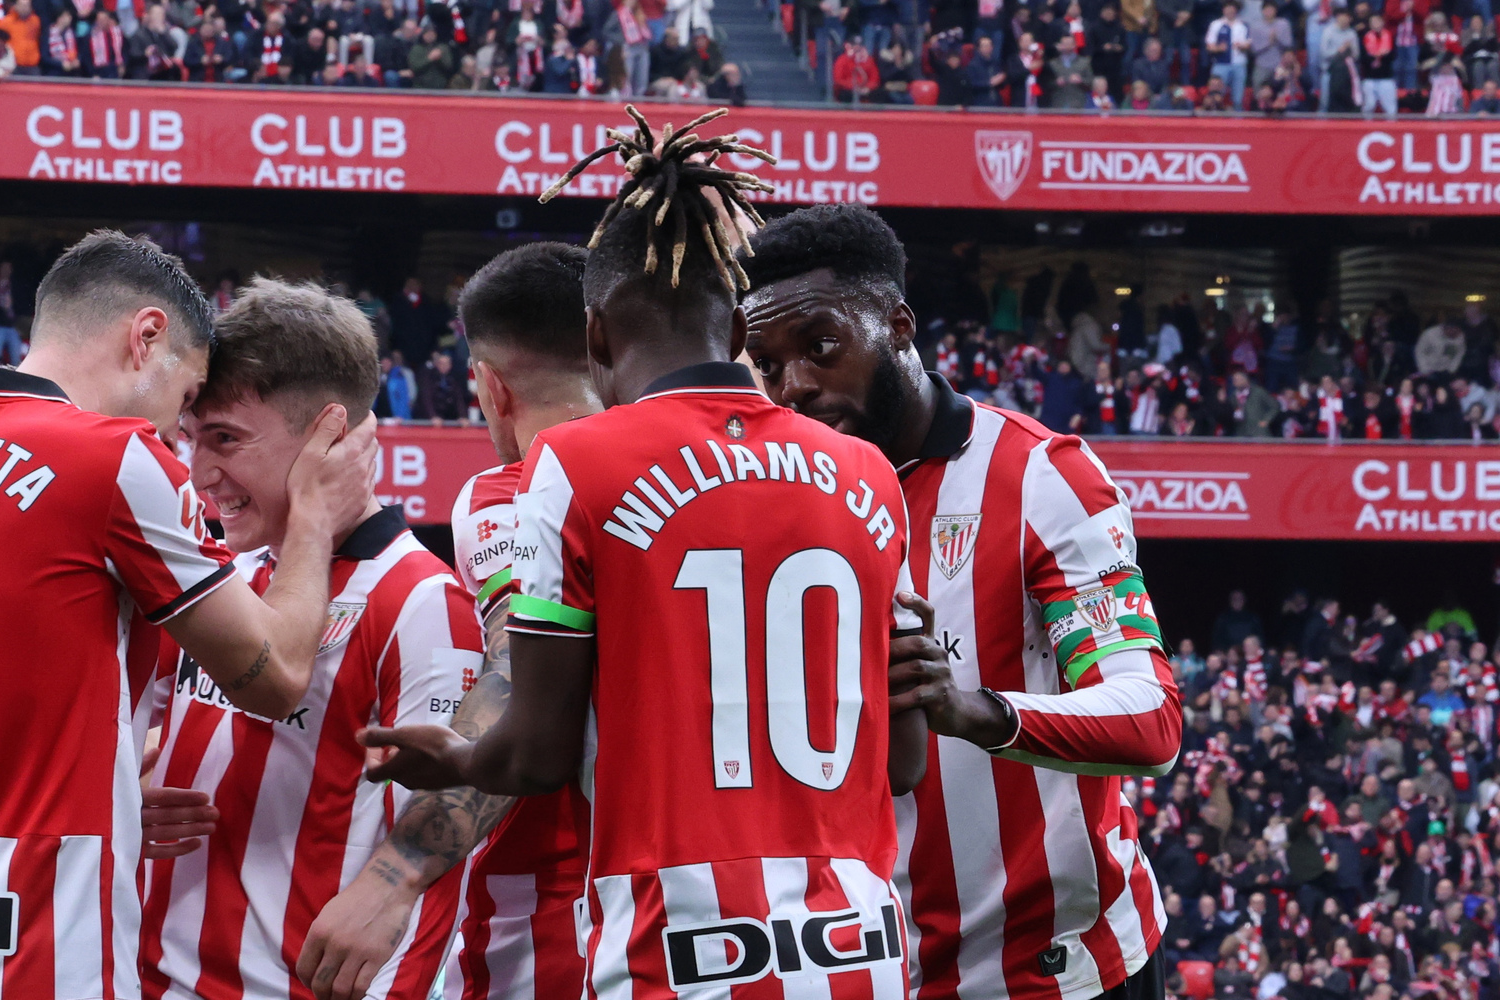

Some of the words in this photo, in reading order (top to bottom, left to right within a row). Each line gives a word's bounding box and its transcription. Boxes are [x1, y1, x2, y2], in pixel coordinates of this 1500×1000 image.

[26, 105, 184, 150] CLUB
[250, 113, 407, 158] CLUB
[727, 127, 880, 172] CLUB
[29, 150, 182, 184] ATHLETIC
[253, 158, 405, 191] ATHLETIC
[497, 165, 626, 197] ATHLETI
[1042, 148, 1250, 184] FUNDAZIOA
[602, 439, 839, 552] WILLIAMS
[844, 478, 897, 552] JR
[940, 558, 963, 577] BILBAO
[673, 547, 864, 792] 10
[664, 903, 902, 987] DIGI
